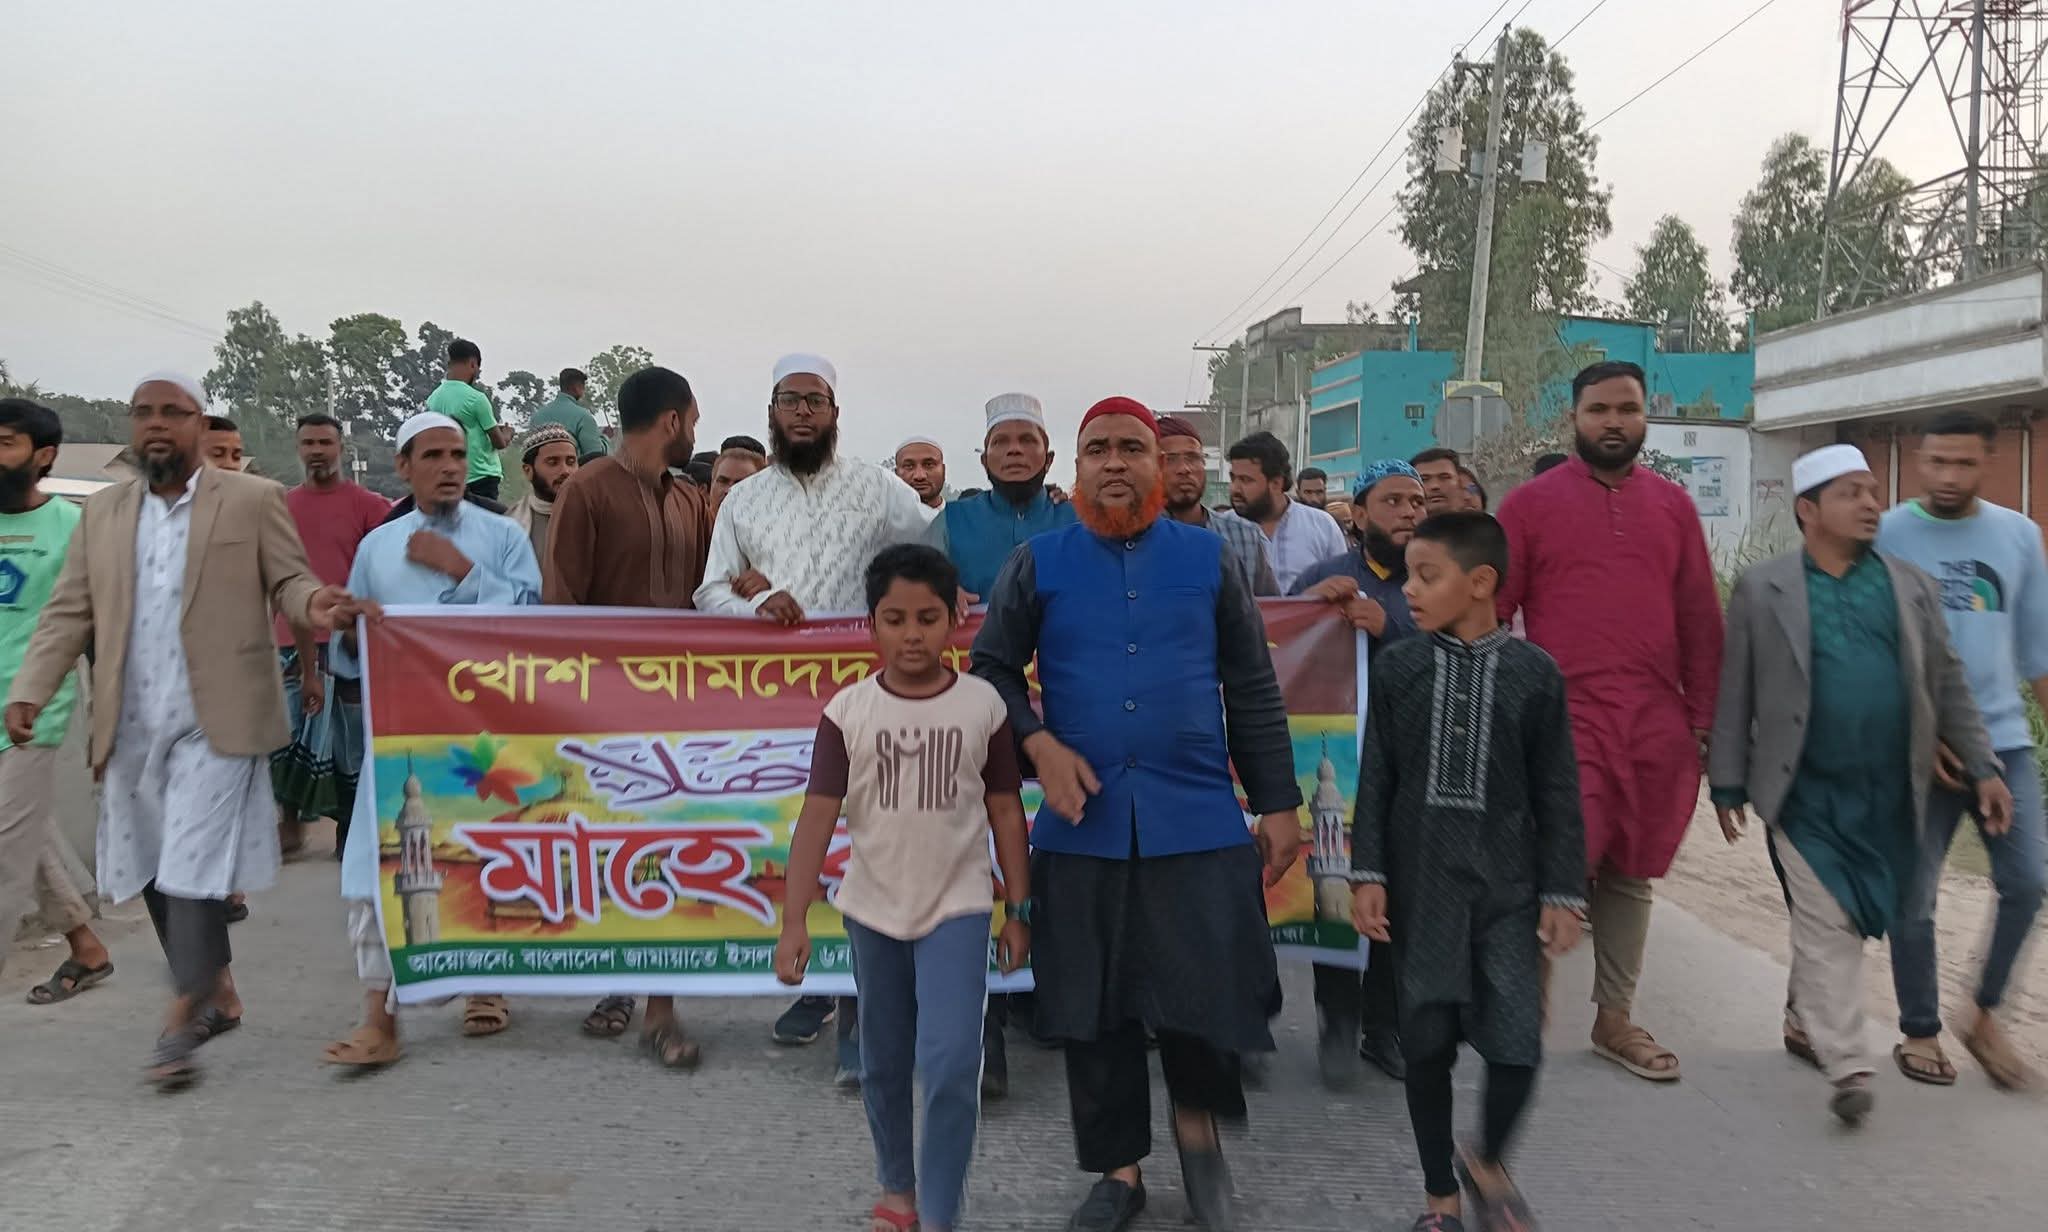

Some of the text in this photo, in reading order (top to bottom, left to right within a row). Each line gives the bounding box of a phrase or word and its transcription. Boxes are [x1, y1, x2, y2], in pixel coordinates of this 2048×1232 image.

[447, 650, 878, 704] খোশ আমদেদ
[455, 814, 774, 925] মাহে
[520, 945, 616, 972] বাংলাদেশ
